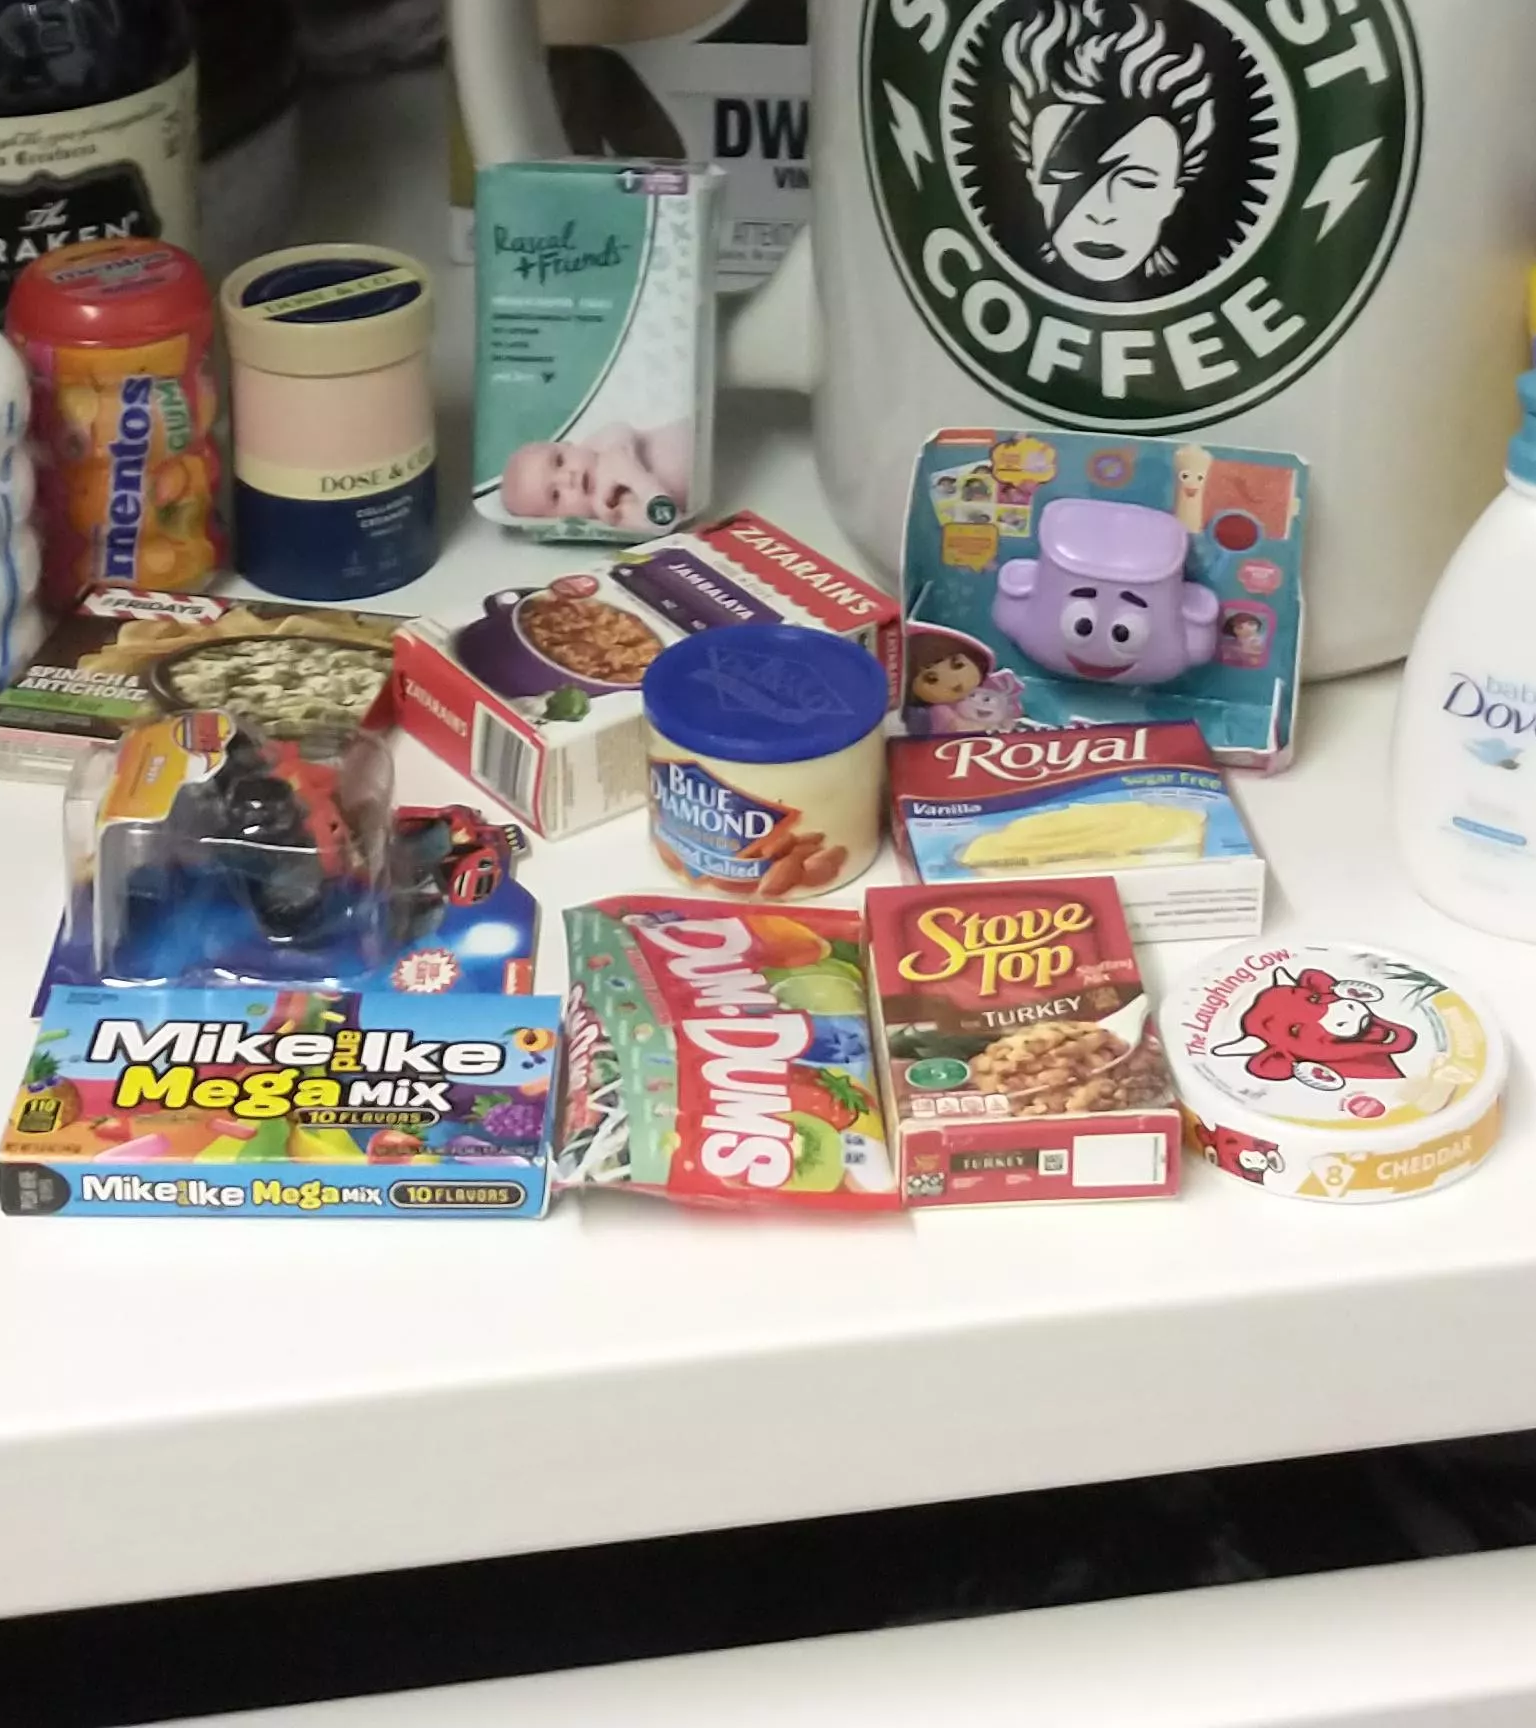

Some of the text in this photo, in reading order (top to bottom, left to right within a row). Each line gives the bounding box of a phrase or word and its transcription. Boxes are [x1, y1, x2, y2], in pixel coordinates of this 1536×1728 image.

[922, 225, 1307, 400] COFFEE
[105, 376, 153, 580] mentos
[321, 462, 405, 495] DOSE &
[667, 562, 756, 621] JAMBALAYA
[728, 526, 882, 616] ZATARAIN'S
[17, 677, 149, 702] ARTICHOKE
[28, 665, 126, 687] SPINACH
[935, 728, 1149, 782] Royal
[649, 767, 775, 839] DIAMOND
[668, 761, 734, 813] BLUE
[911, 801, 983, 819] Vanilla
[897, 902, 1094, 983] Stove
[963, 943, 1076, 998] Top
[982, 995, 1083, 1029] TURKEY
[1181, 948, 1291, 1057] The Laughing Cow
[88, 1017, 332, 1067] Mike
[362, 1030, 507, 1076] Ike
[113, 1064, 343, 1120] Mega
[308, 1110, 423, 1126] 10 FLAVORS
[1325, 1164, 1344, 1187] 8
[1376, 1134, 1474, 1183] CHEDDAR
[80, 1174, 179, 1207] Mike
[188, 1178, 247, 1210] Ike
[251, 1178, 341, 1212] Mega
[405, 1185, 433, 1205] 10
[433, 1186, 511, 1205] FLAVORS
